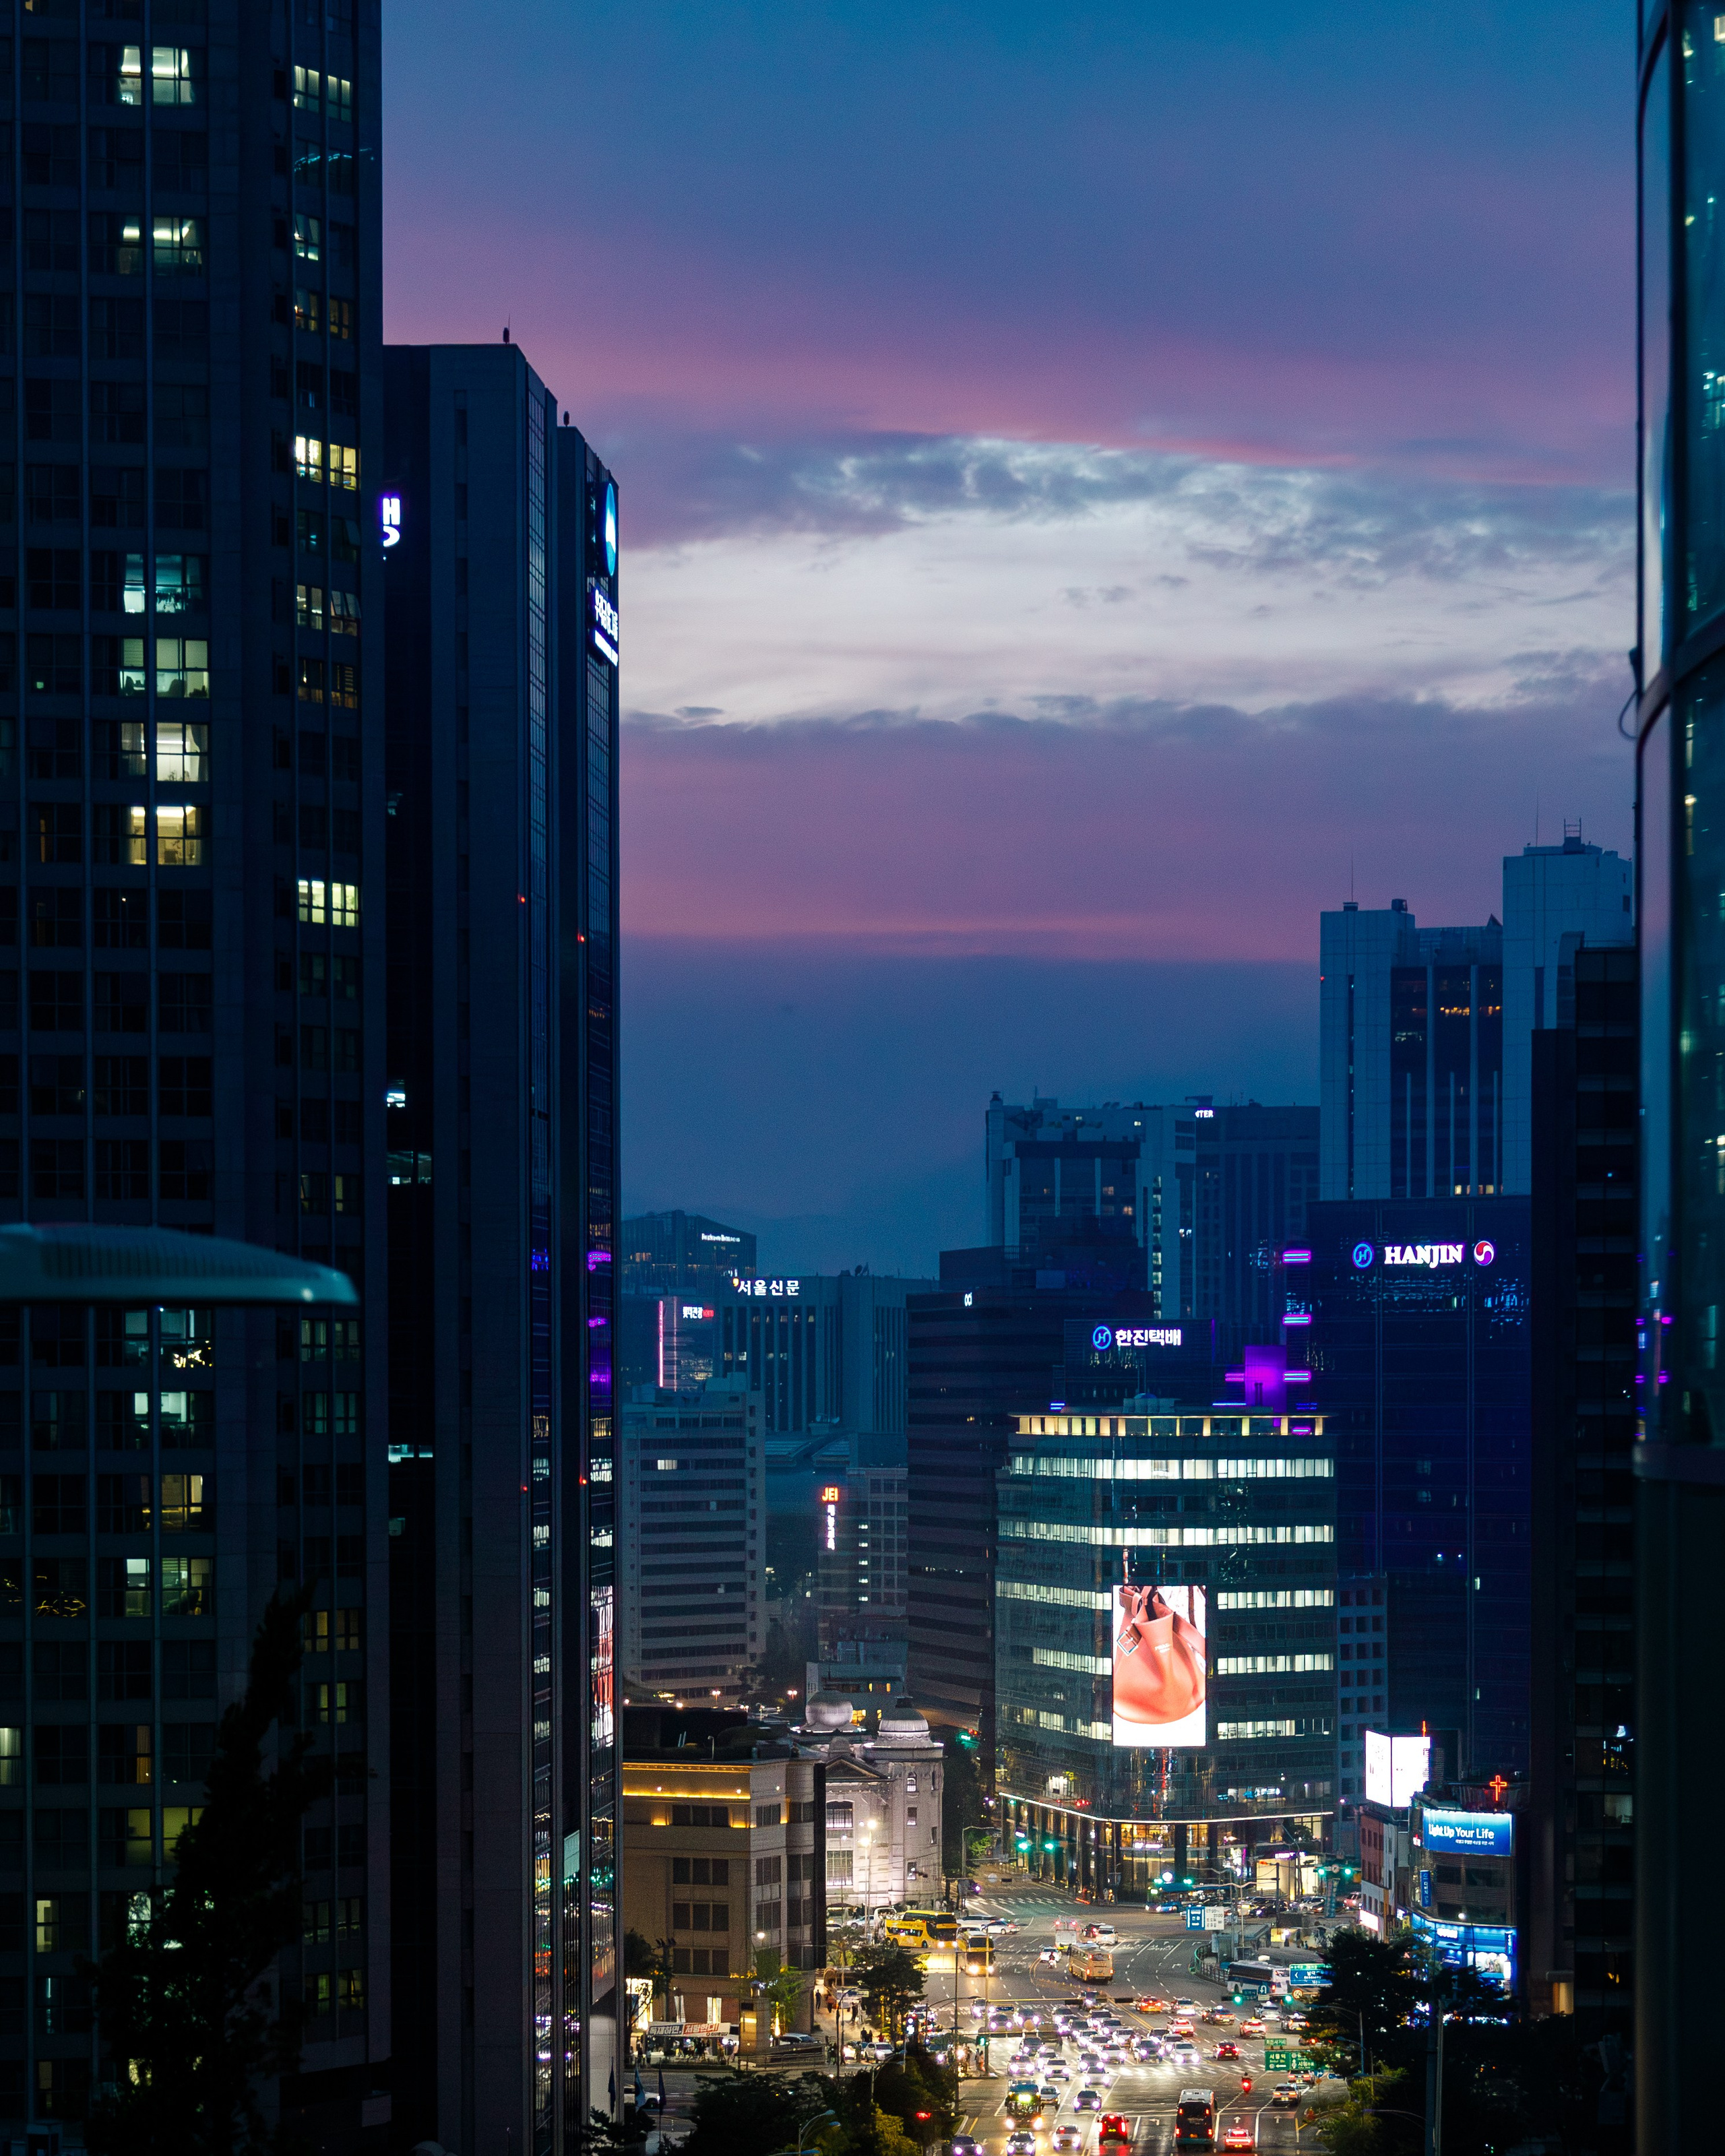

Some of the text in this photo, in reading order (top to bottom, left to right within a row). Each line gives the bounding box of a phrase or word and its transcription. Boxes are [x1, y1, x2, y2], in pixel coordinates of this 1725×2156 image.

[1385, 1245, 1463, 1268] HANJIN
[738, 1280, 800, 1296] 서울신문
[1115, 1329, 1181, 1346] 한진택배
[822, 1488, 838, 1501] JEI
[1429, 1824, 1495, 1839] Light Up Your Life
